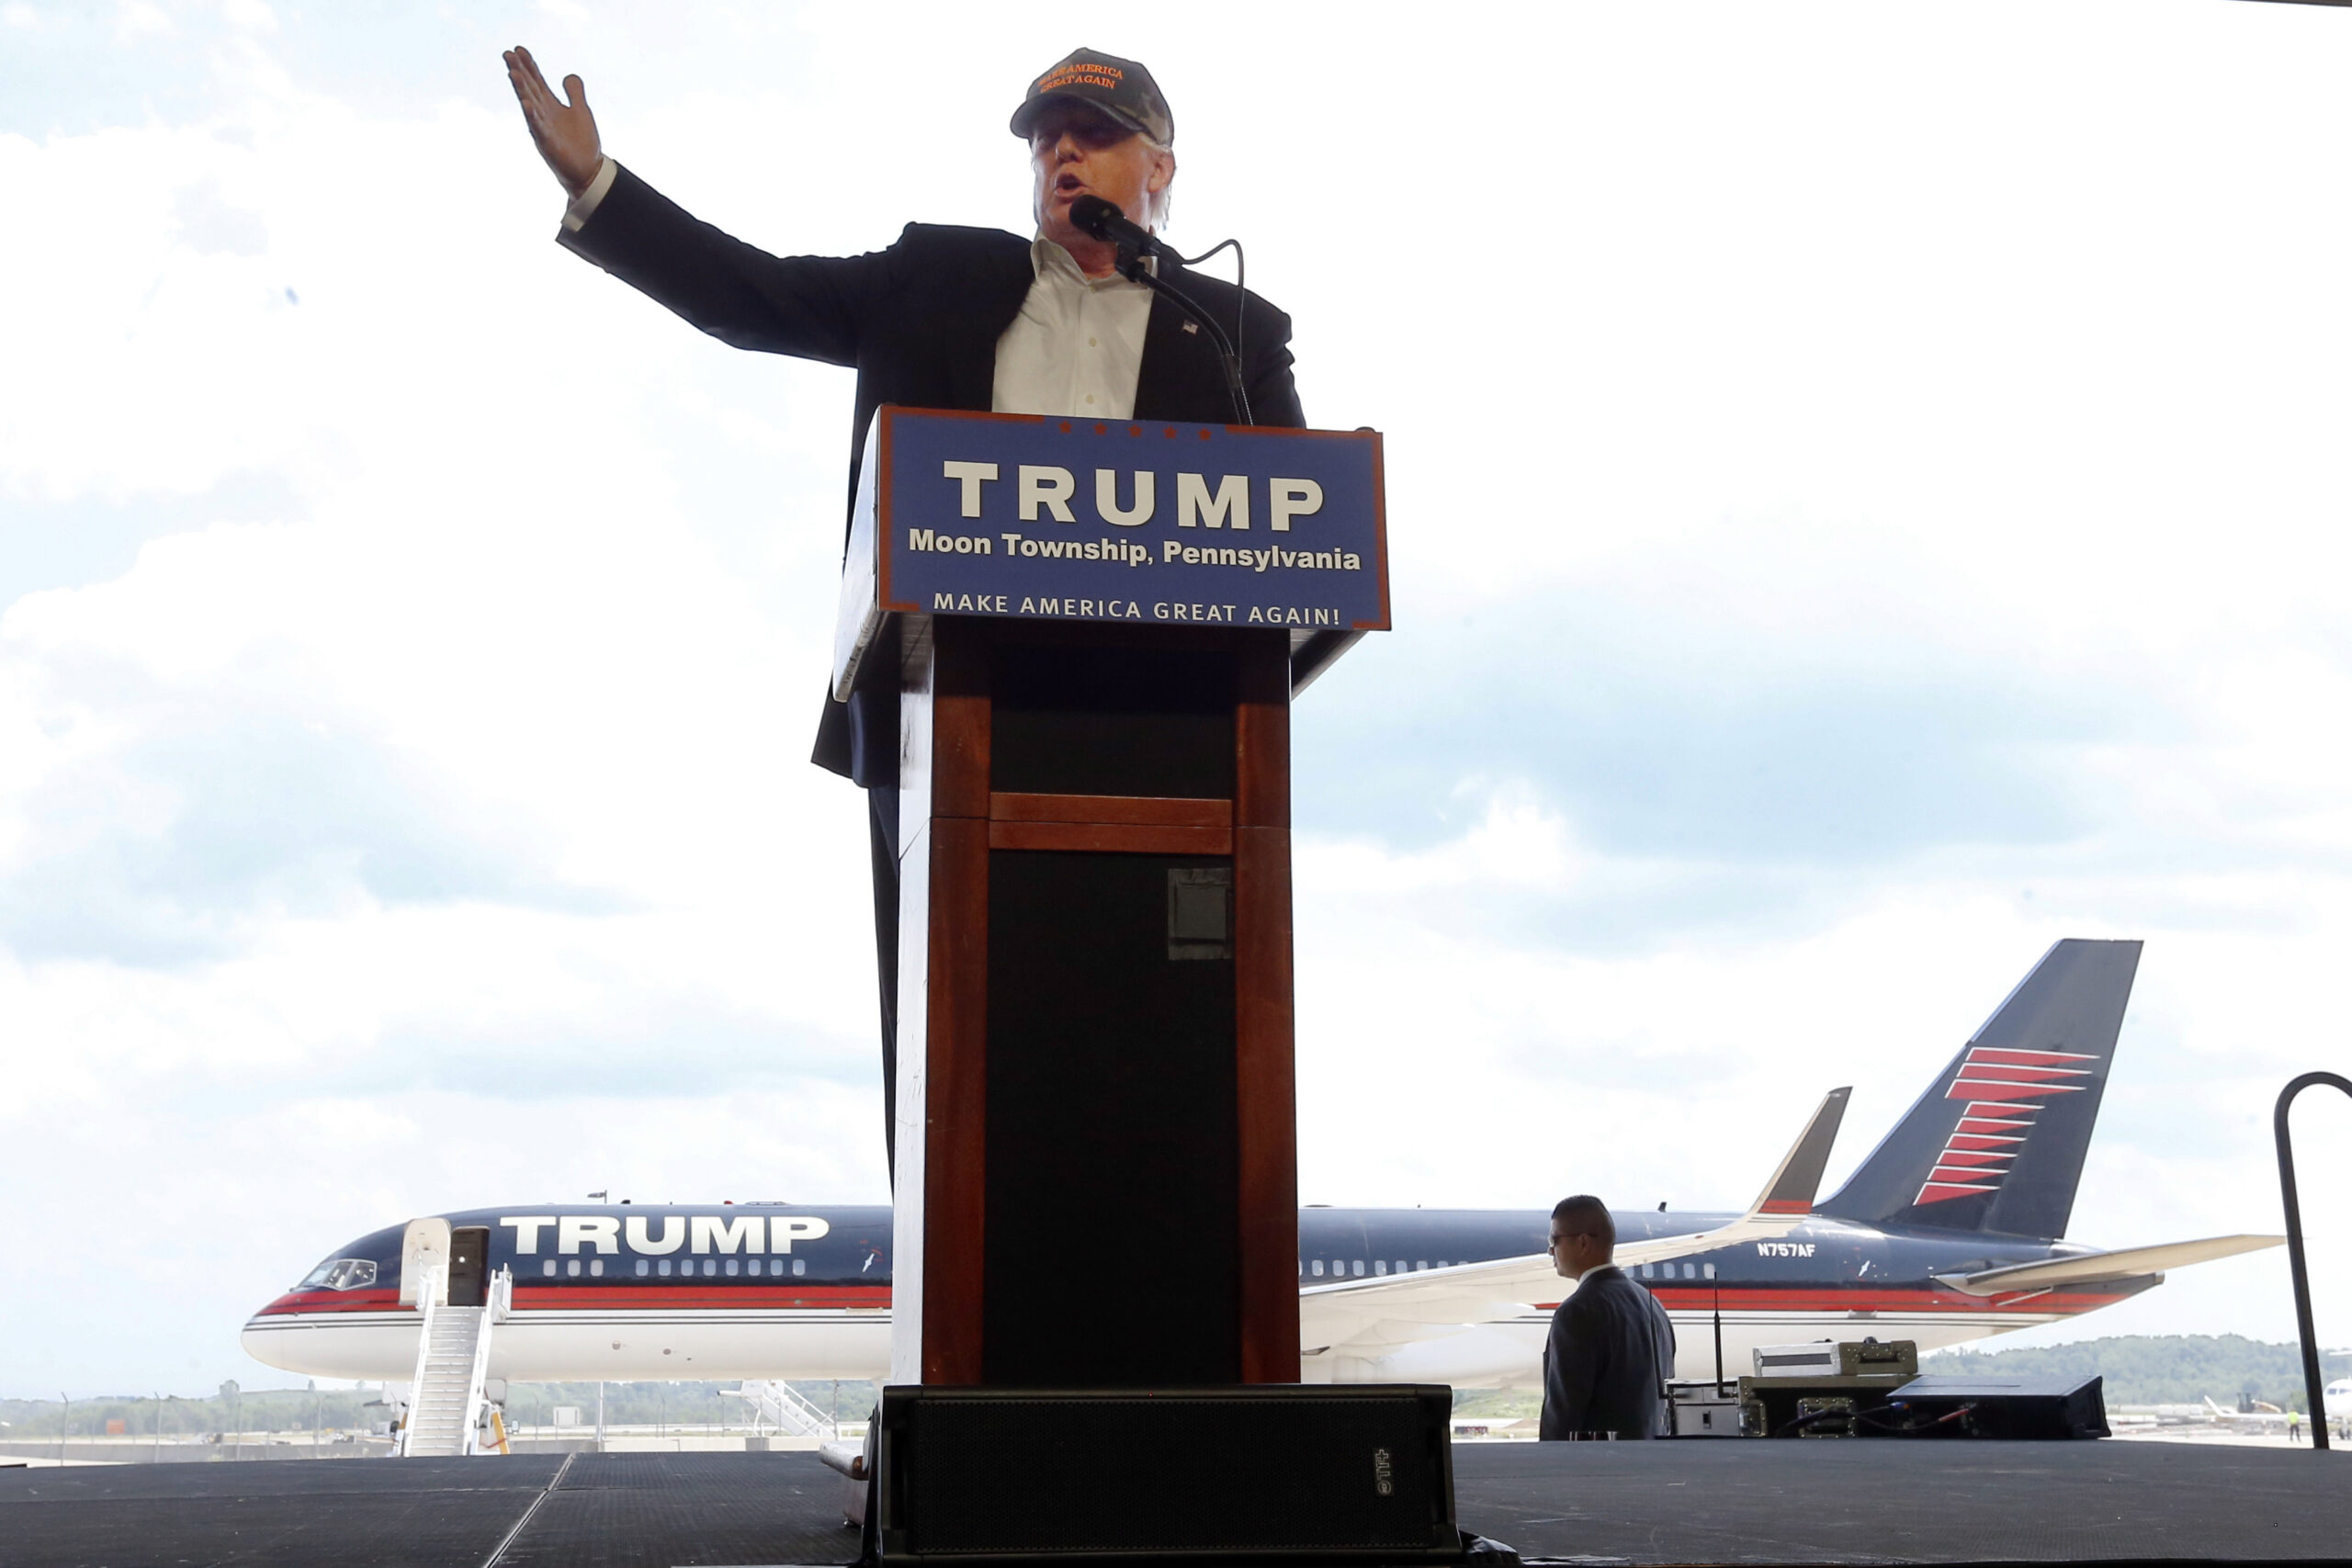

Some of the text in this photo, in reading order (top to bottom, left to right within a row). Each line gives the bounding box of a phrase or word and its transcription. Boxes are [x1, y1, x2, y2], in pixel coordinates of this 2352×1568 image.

[1040, 74, 1115, 94] GREAT AGAIN
[1067, 63, 1124, 80] AMERICA
[944, 460, 1324, 531] TRUMP
[909, 528, 1361, 573] Moon Township, Pennsylvania
[933, 592, 1340, 626] MAKE AMERICA GREAT AGAIN!
[499, 1215, 831, 1256] TRUMP
[1757, 1242, 1815, 1258] N757AF
